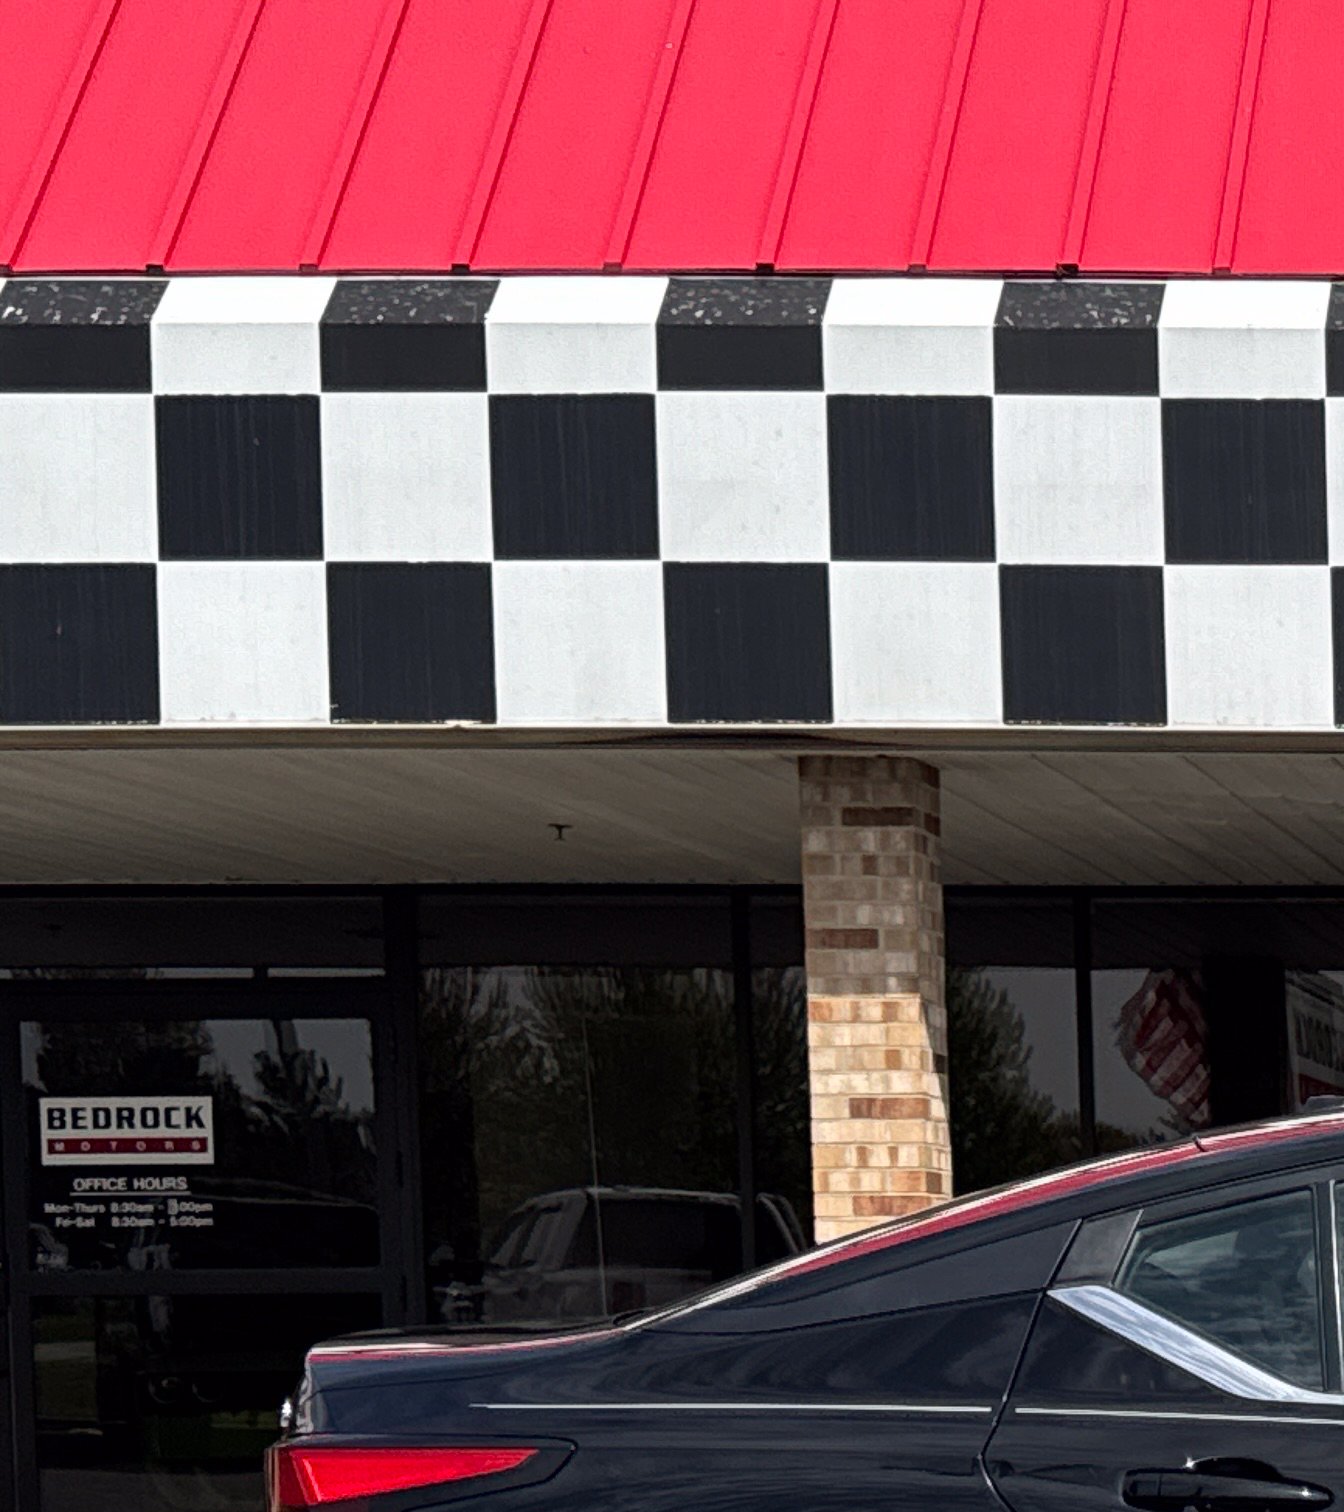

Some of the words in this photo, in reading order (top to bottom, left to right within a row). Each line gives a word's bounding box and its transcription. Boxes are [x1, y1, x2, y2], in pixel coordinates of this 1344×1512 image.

[47, 1106, 206, 1130] BEDROCK
[53, 1140, 202, 1152] MOTORS
[72, 1176, 128, 1191] OFFICE
[132, 1176, 188, 1191] HOURS
